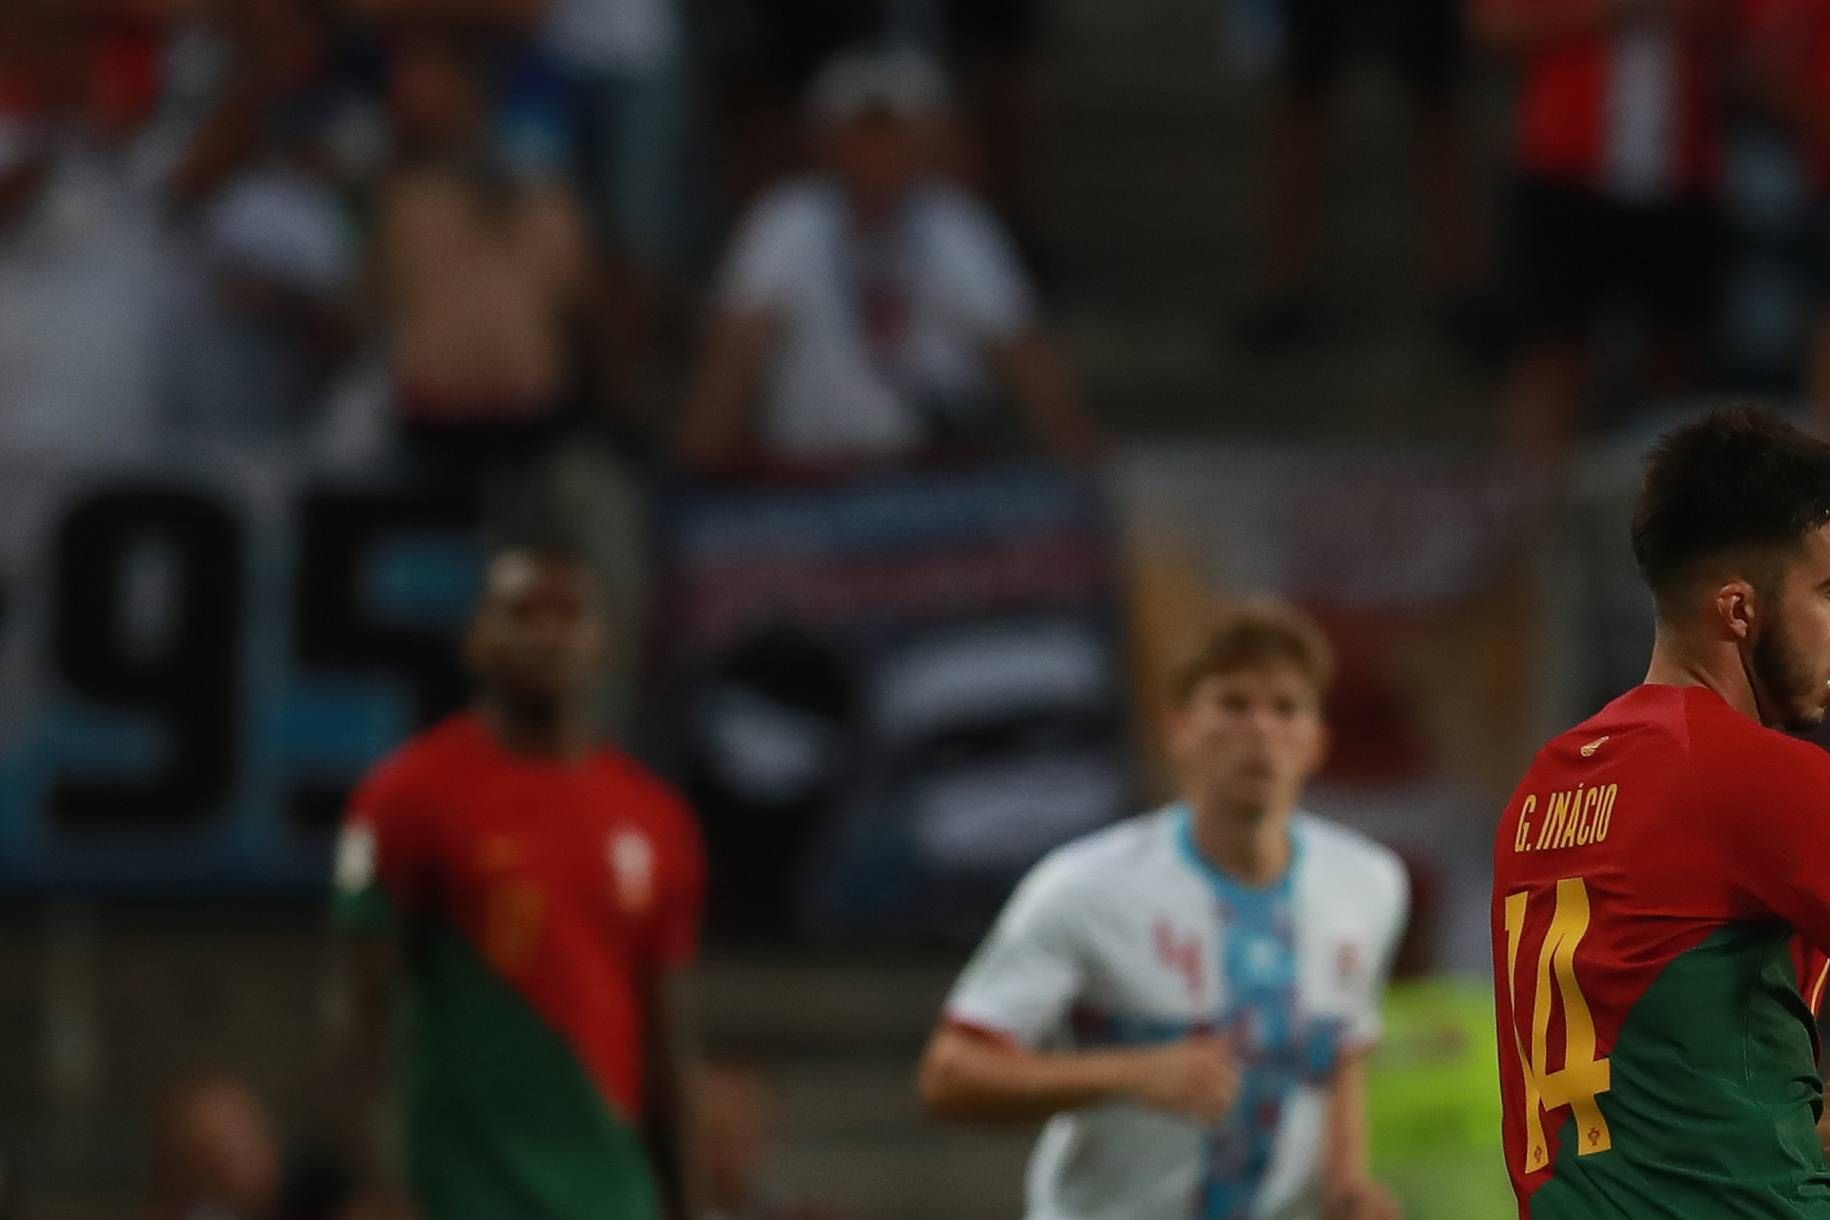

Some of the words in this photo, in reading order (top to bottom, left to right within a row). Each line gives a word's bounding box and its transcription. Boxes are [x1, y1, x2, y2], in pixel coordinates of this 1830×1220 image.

[1515, 794, 1536, 852] G.
[1537, 783, 1619, 850] INÁCIO
[1505, 877, 1611, 1174] 14
